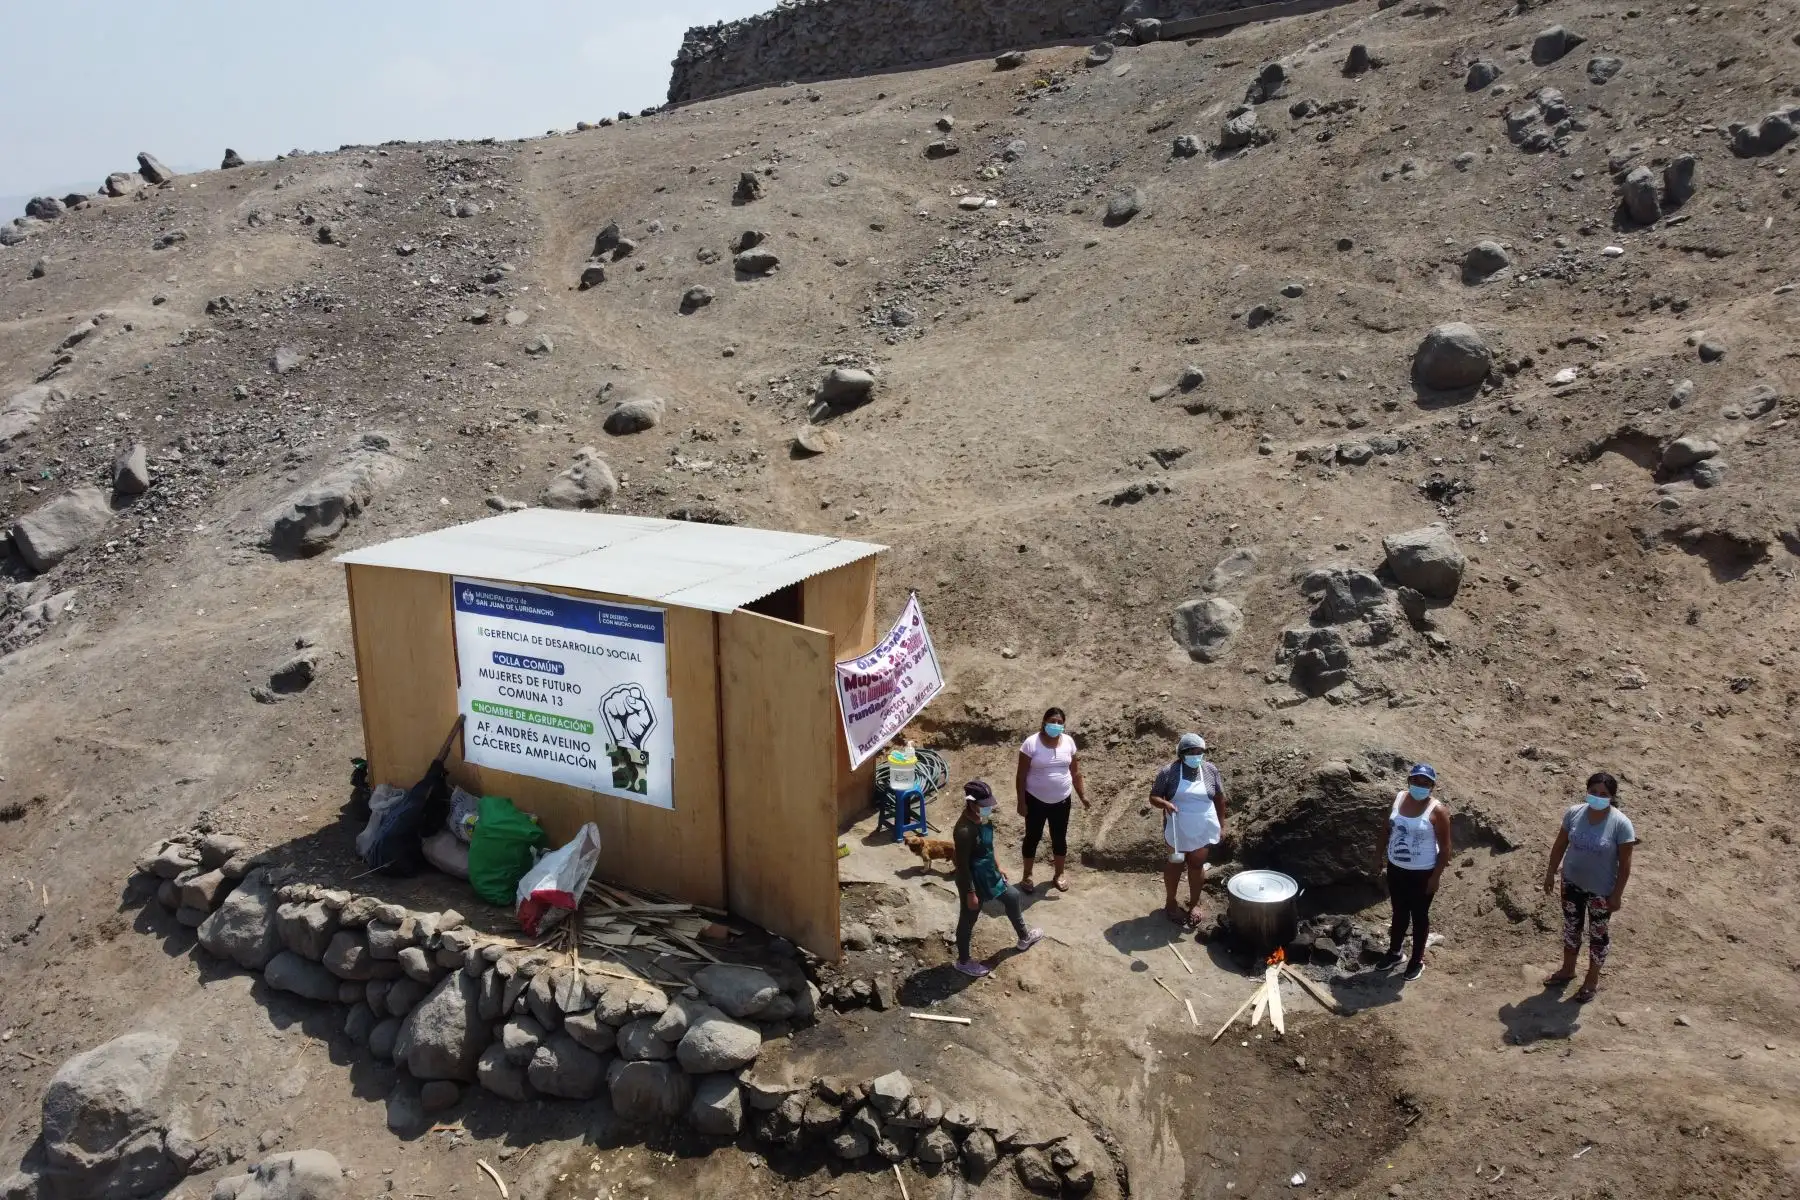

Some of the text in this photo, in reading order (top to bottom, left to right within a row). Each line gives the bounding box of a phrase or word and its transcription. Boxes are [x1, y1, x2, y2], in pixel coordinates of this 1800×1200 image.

[475, 591, 519, 603] MUNICIPALIDAD
[475, 599, 488, 607] SAN
[489, 601, 505, 609] JUAN
[515, 605, 554, 617] LURIGANCHO
[484, 628, 642, 663] GERENCIA DE DESARROLLO SOCIAL
[479, 668, 582, 695] MUJERES DE FUTURO
[498, 686, 564, 707] COMUNA 13
[515, 710, 526, 721] DE
[477, 721, 591, 753] AF. ANDRÉS AVELINO
[472, 734, 597, 771] CÁCERES AMPLIACIÓN
